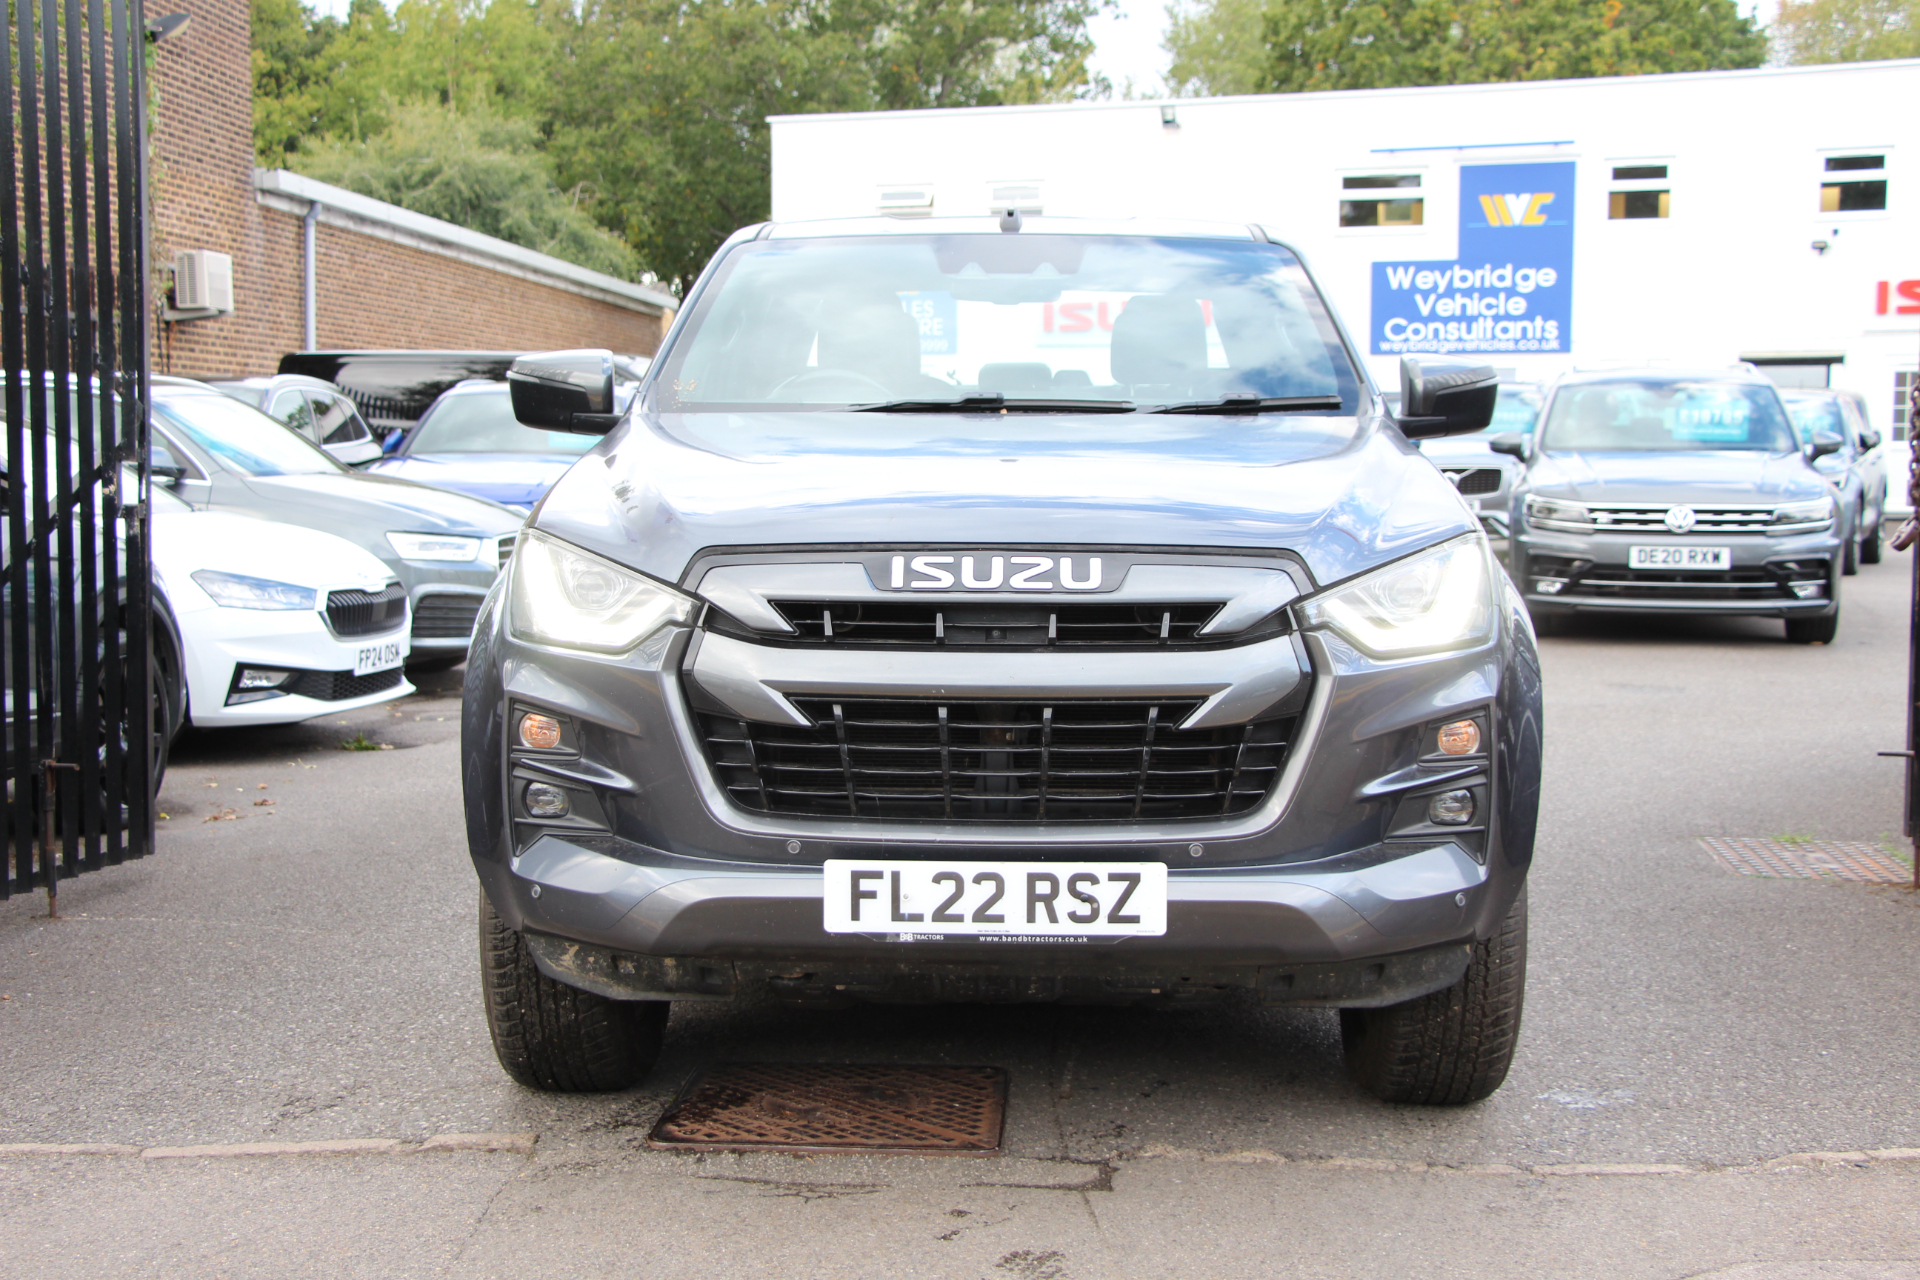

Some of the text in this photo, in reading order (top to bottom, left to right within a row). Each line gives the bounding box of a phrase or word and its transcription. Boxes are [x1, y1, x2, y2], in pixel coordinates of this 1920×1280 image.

[1386, 263, 1557, 293] Weybridge
[1414, 292, 1527, 317] Vehicle
[1384, 316, 1559, 341] Consultants
[1379, 339, 1560, 353] weybridgevehicles.co.uk
[1638, 549, 1721, 564] DE20 RXW
[891, 555, 1102, 590] ISUZU
[359, 646, 382, 669] FP24
[850, 870, 1141, 924] FL22 RSZ
[979, 935, 1088, 943] www.bandbtractors.co.uk
